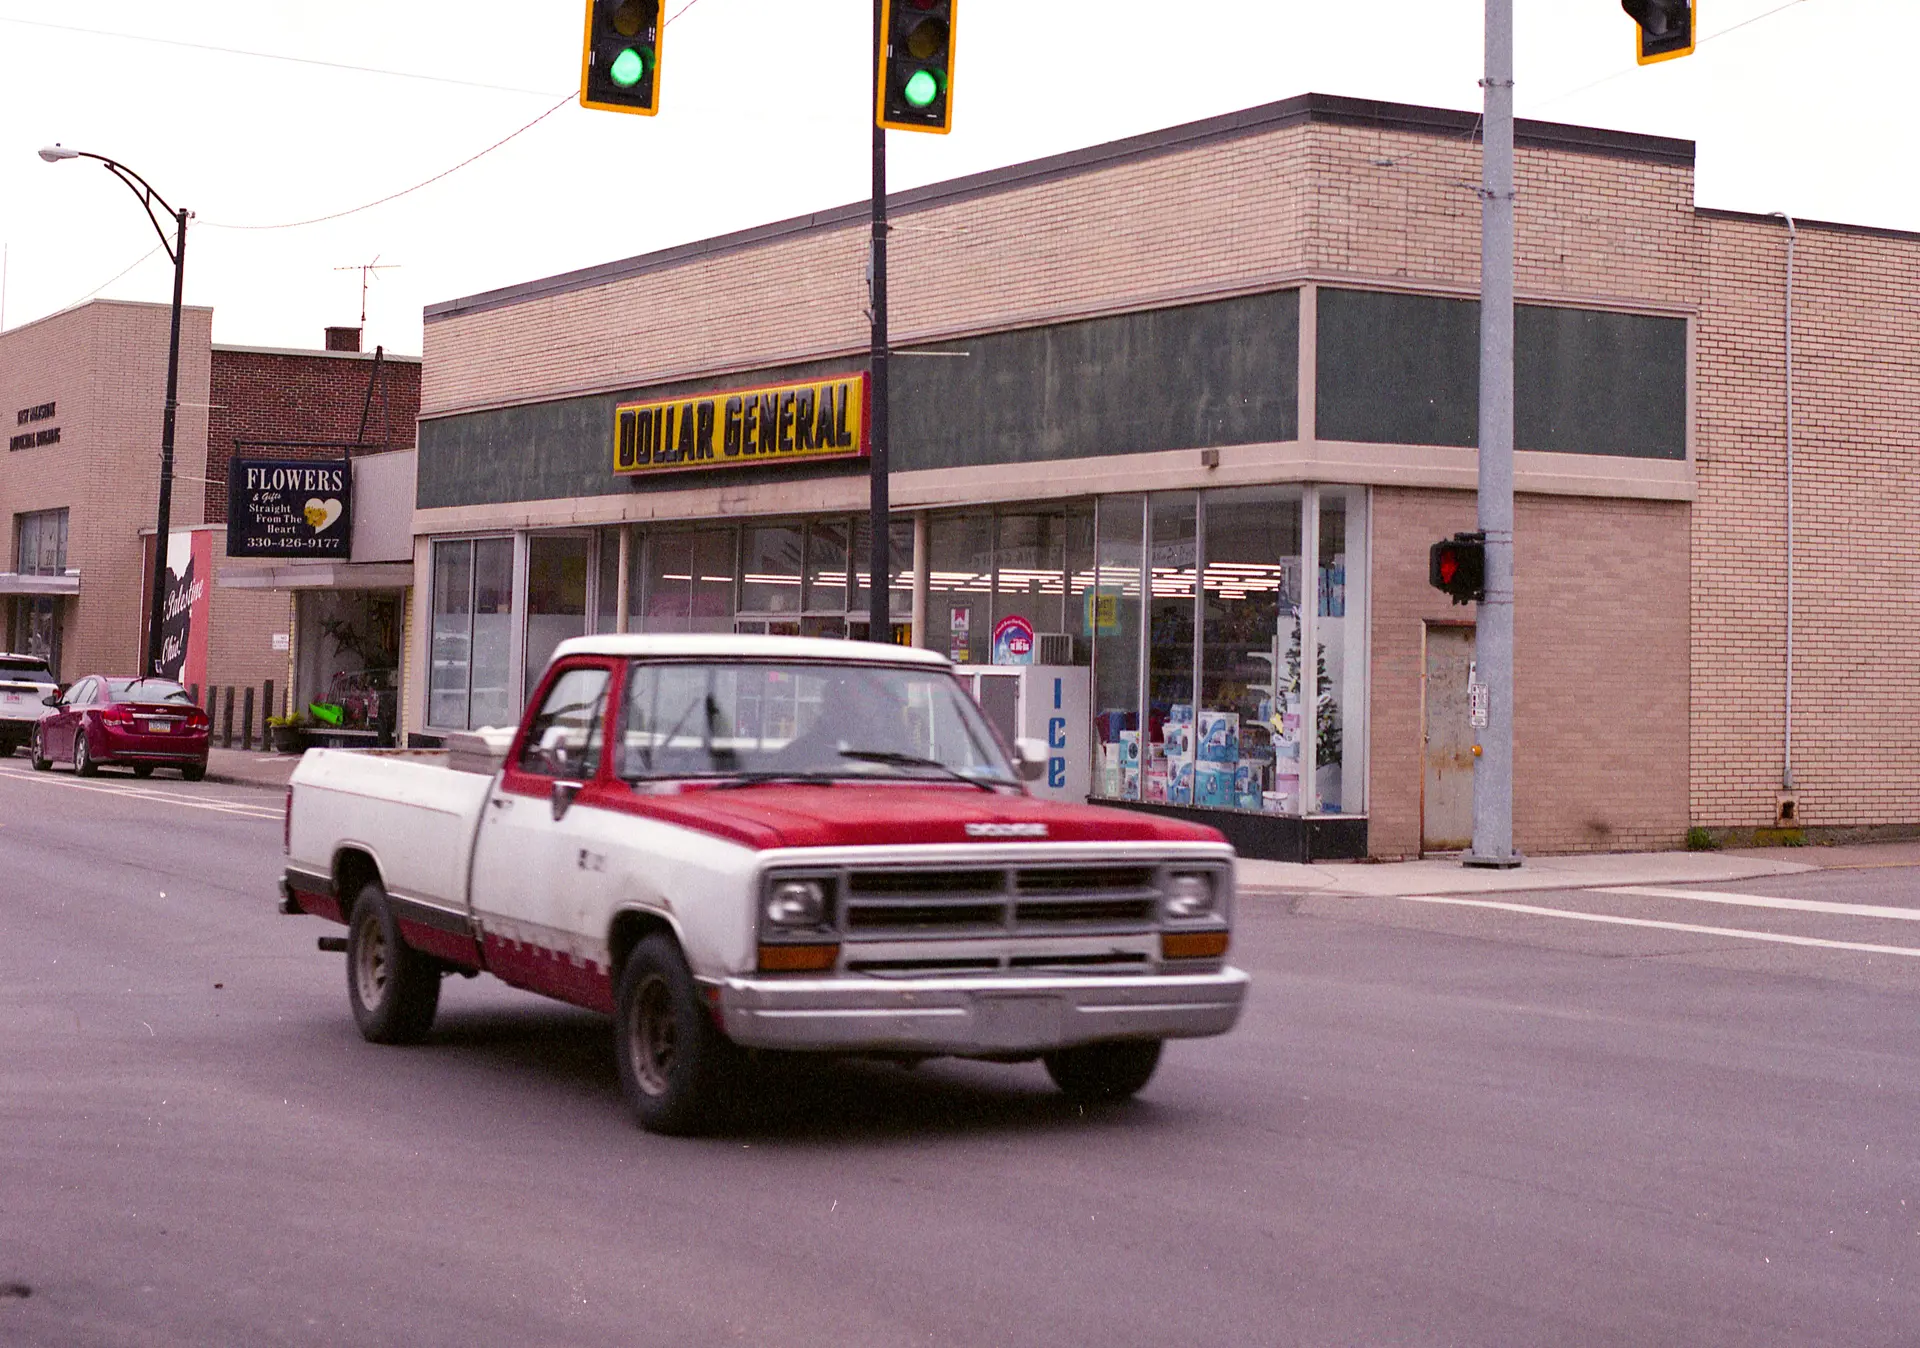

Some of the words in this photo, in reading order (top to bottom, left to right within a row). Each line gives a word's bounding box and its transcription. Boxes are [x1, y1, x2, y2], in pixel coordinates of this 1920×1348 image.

[619, 400, 714, 467] DOLLAR
[723, 383, 851, 456] GENERAL
[247, 468, 342, 491] FLOWERS
[252, 493, 259, 501] &
[261, 491, 281, 503] Gifts
[249, 503, 291, 514] Straight
[256, 514, 281, 523] From
[284, 514, 302, 523] The
[267, 525, 296, 534] Heart
[247, 537, 339, 548] 330-426-9177
[166, 578, 203, 620] Palestine
